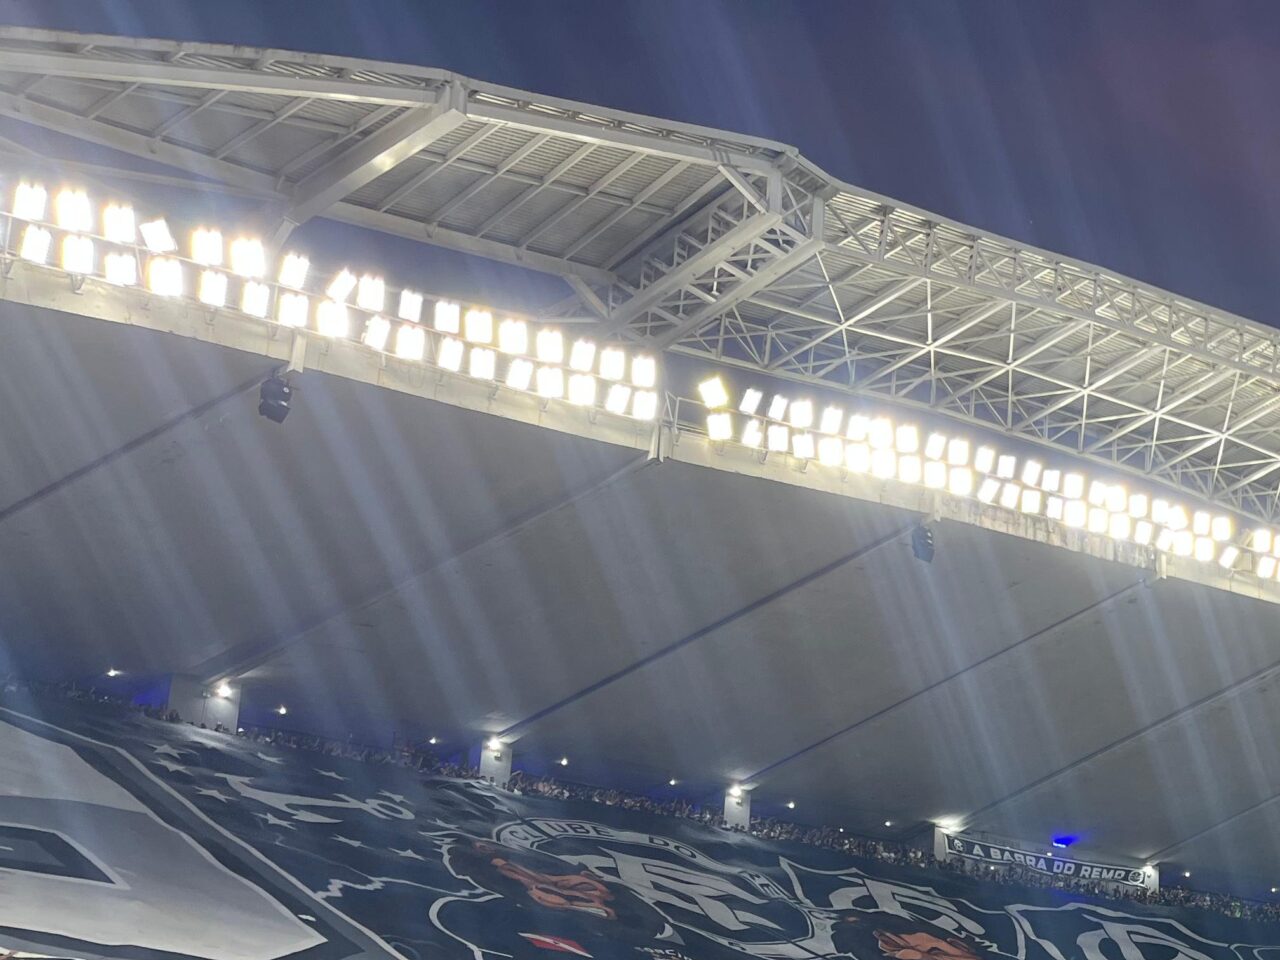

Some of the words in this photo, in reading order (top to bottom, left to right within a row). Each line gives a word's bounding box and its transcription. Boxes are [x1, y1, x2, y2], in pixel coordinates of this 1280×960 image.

[972, 845, 984, 857] A
[990, 848, 1048, 871] BARRA
[1053, 862, 1076, 875] DO
[1080, 865, 1126, 880] REMO
